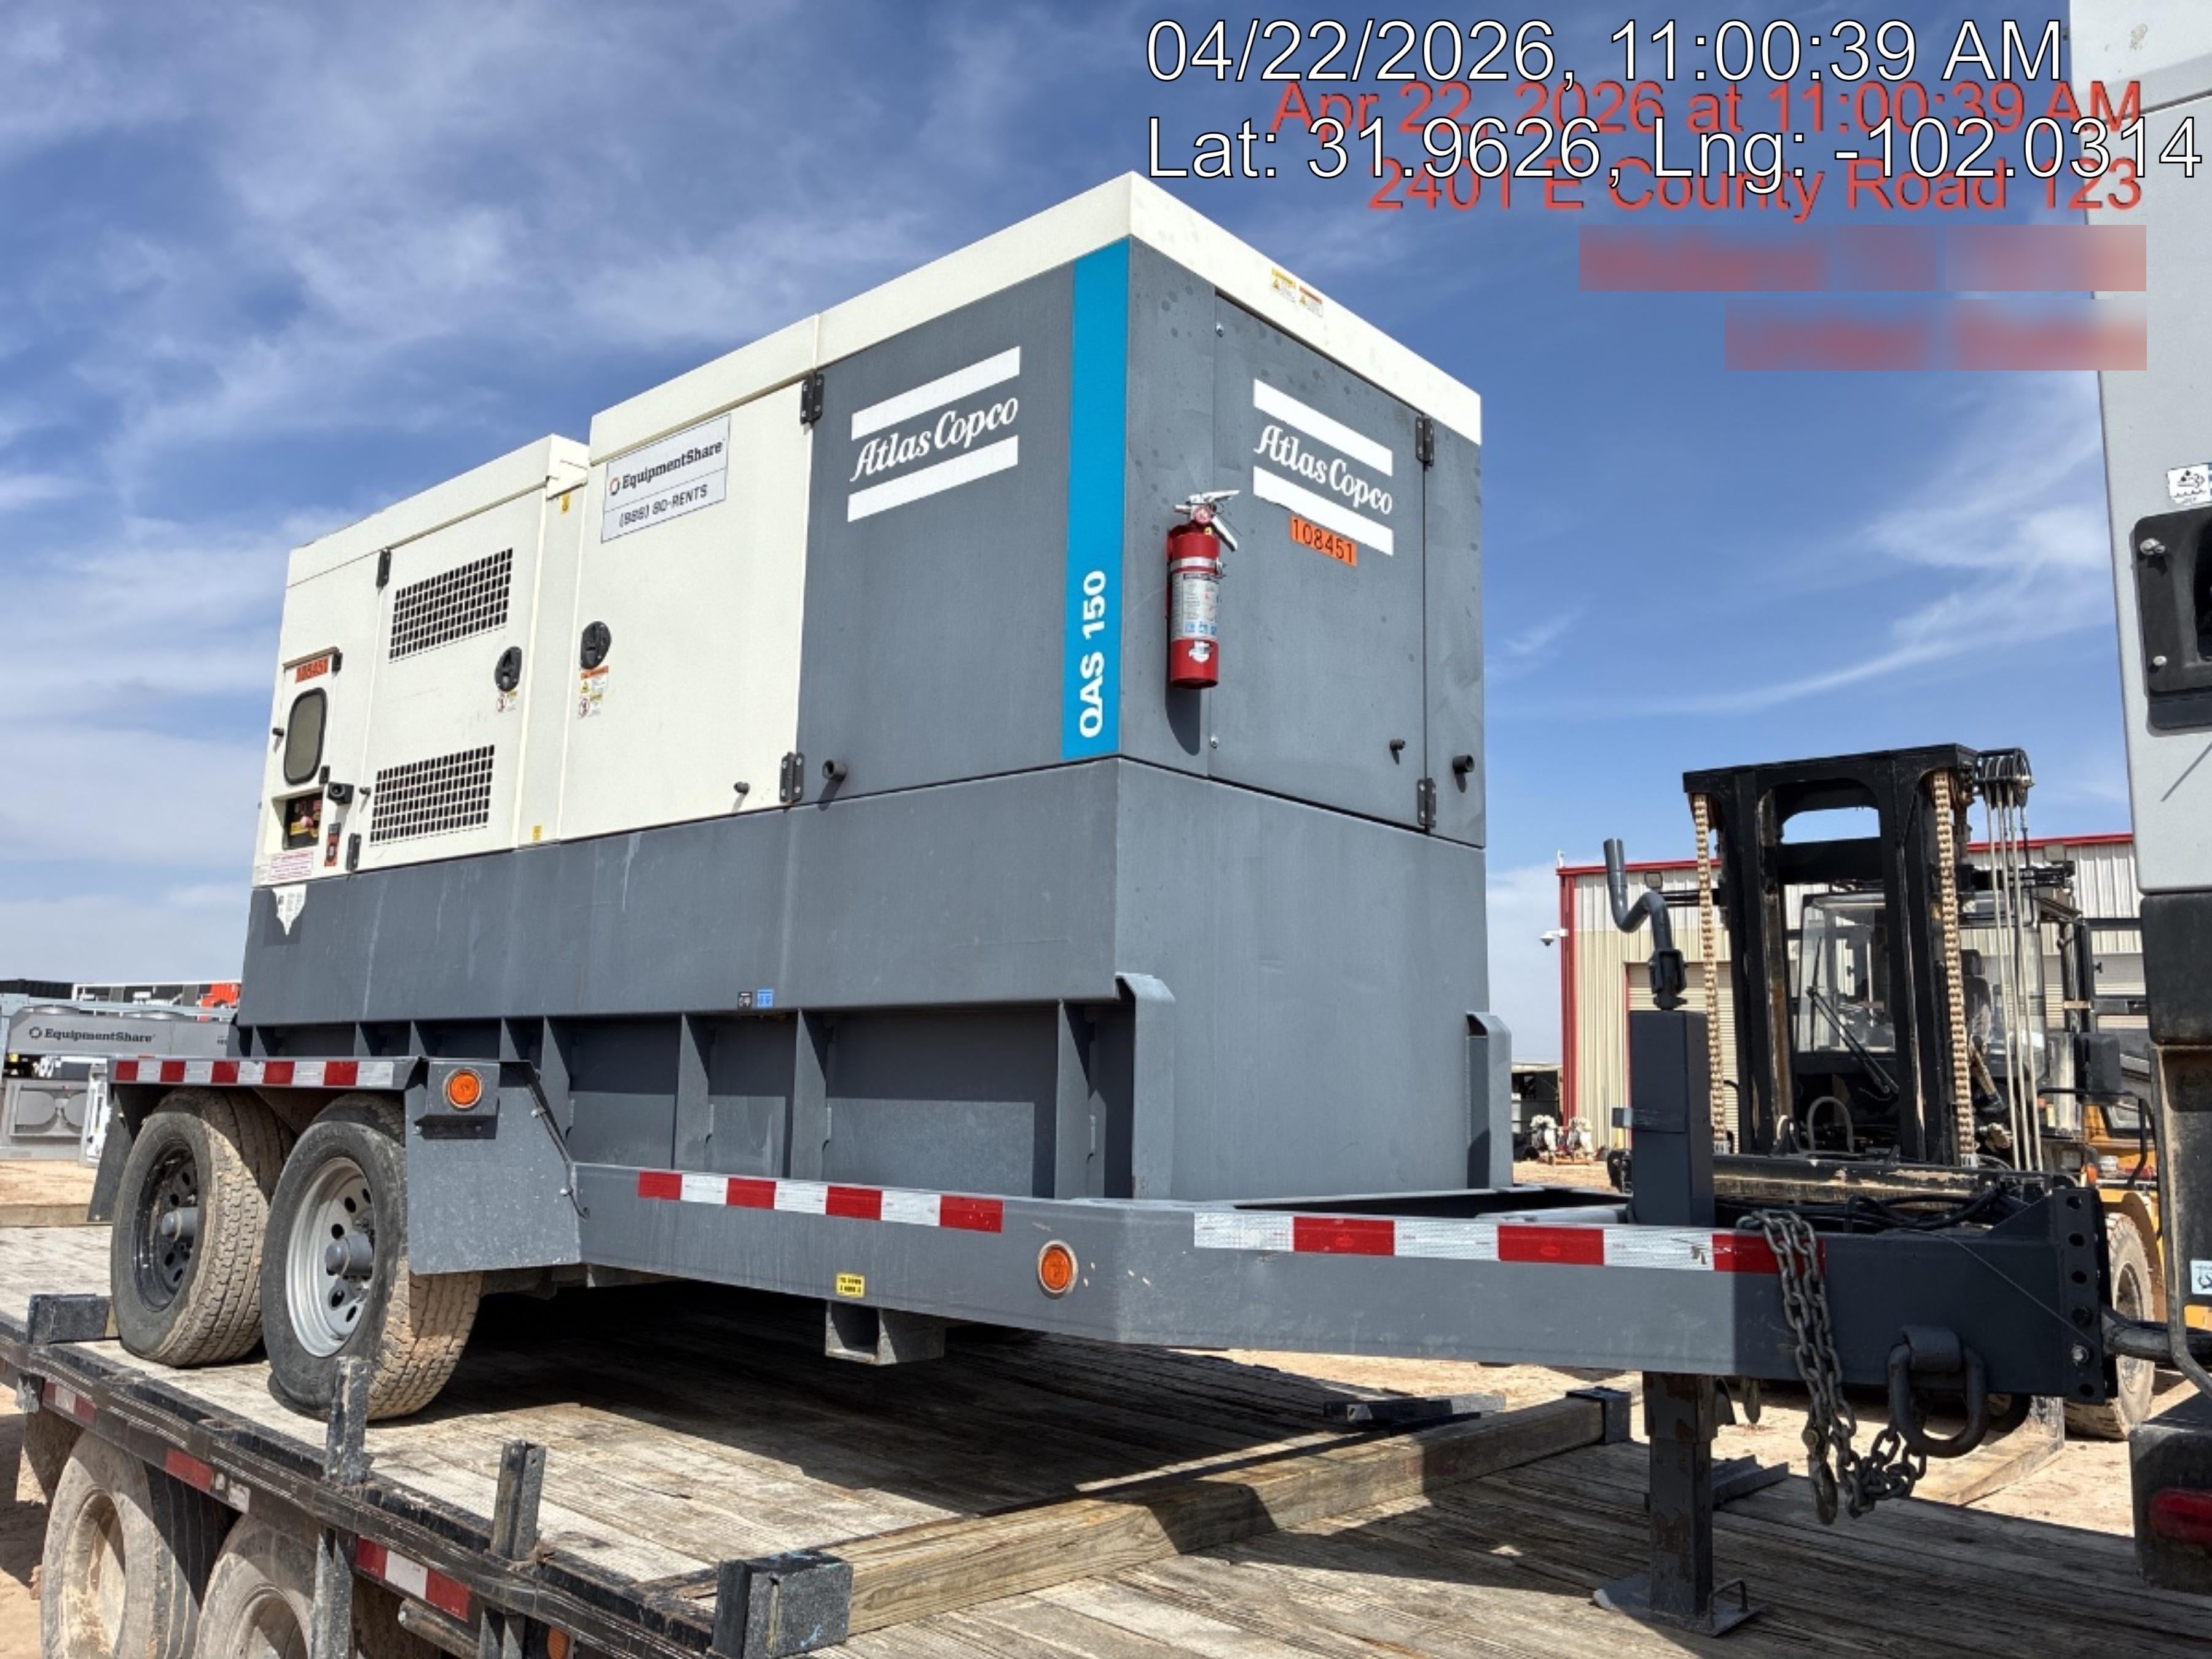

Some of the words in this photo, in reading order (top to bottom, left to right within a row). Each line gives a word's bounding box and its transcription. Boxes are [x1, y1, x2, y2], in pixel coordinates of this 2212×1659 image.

[622, 441, 723, 489] EquipmentShare
[1293, 519, 1353, 563] 108451
[1081, 570, 1107, 640] 150
[1079, 651, 1105, 738] QAS
[44, 1027, 152, 1042] EquipmentShare
